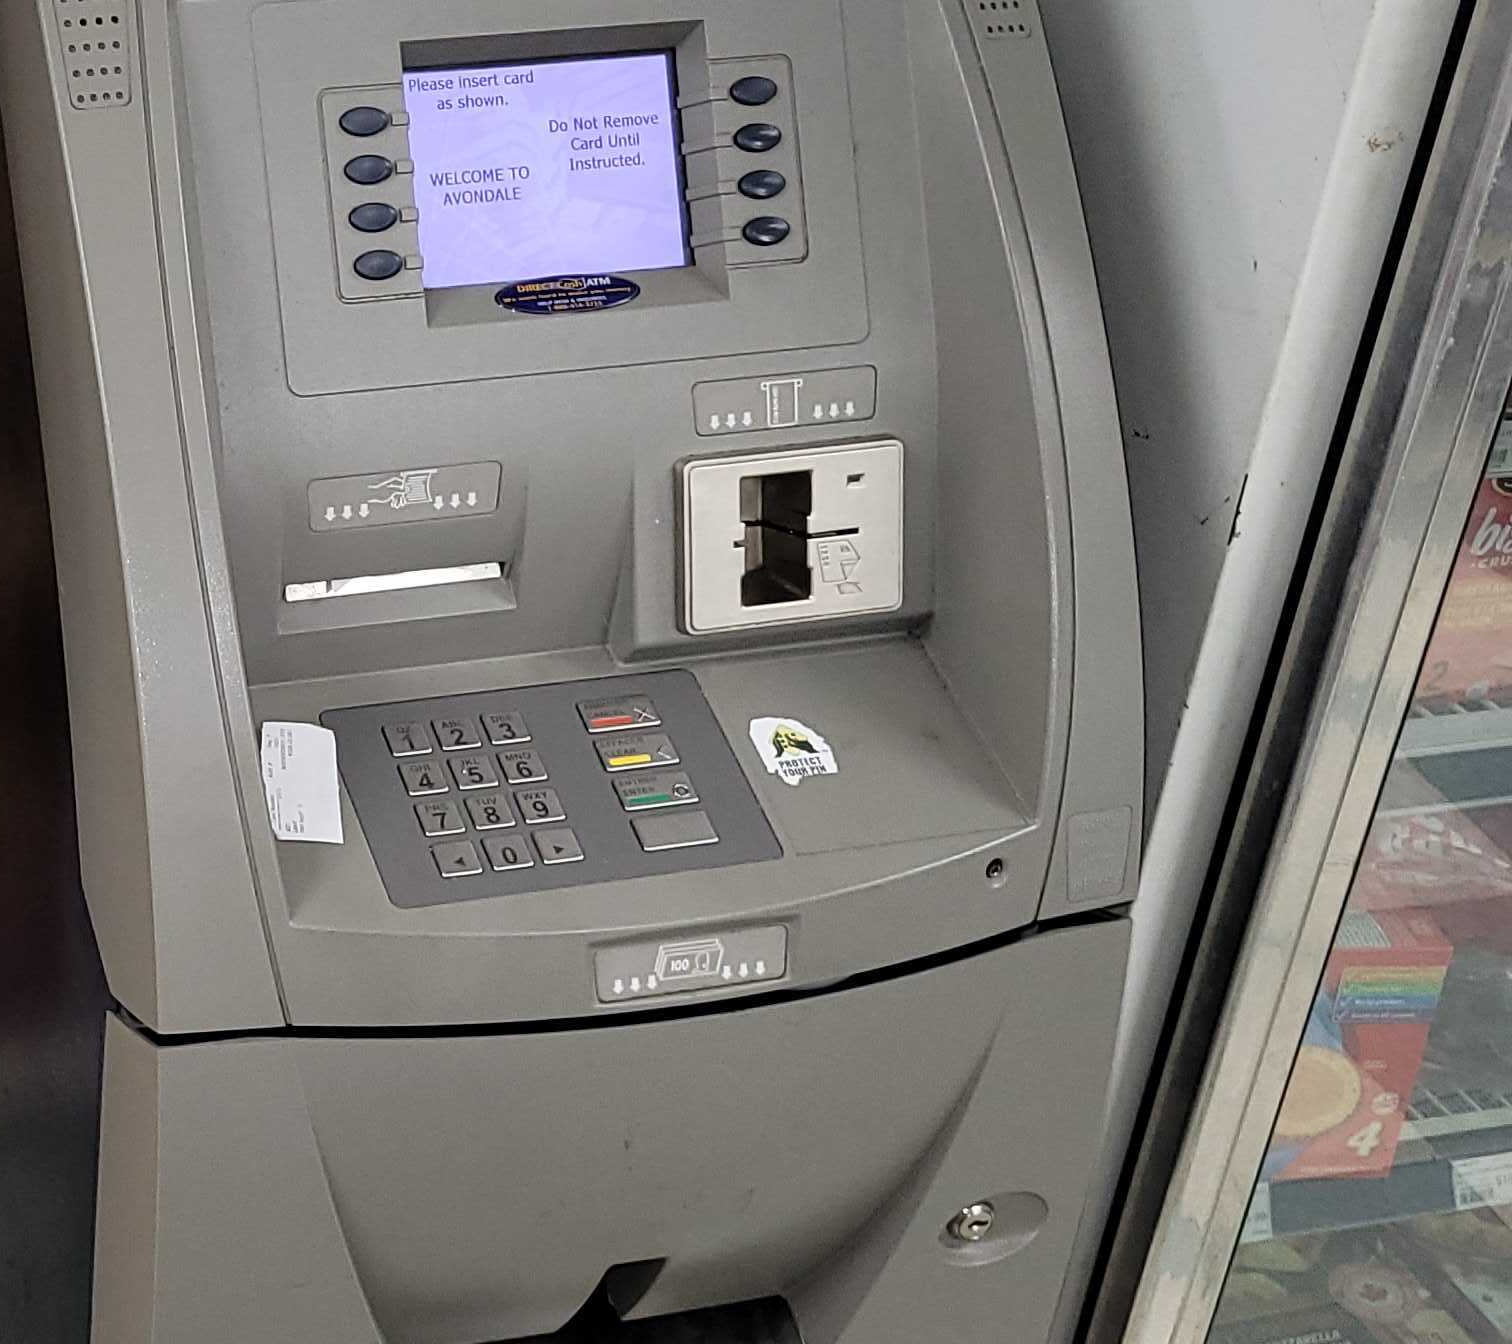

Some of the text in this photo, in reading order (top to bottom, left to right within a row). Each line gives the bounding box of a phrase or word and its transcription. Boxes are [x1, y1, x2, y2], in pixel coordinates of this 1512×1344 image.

[408, 69, 534, 92] Please insert card
[436, 94, 509, 110] as shown.
[548, 114, 659, 133] Do Not Remove
[570, 132, 640, 151] Card Until
[569, 152, 646, 171] Instructed.
[429, 166, 530, 187] WELCOME TO
[443, 187, 522, 206] AVONDALE
[586, 276, 611, 287] ATM
[450, 729, 467, 745] 2
[498, 723, 516, 739] 3
[402, 735, 415, 750] 1
[516, 761, 533, 777] 6
[778, 756, 822, 769] PROTECT
[468, 766, 484, 784] 5
[782, 765, 827, 778] YOUR PIN
[419, 773, 434, 788] 4
[483, 806, 500, 823] 8
[532, 801, 549, 817] 9
[432, 812, 447, 829] 7
[502, 847, 518, 863] 0
[670, 958, 689, 972] 100
[1346, 1120, 1384, 1158] 4
